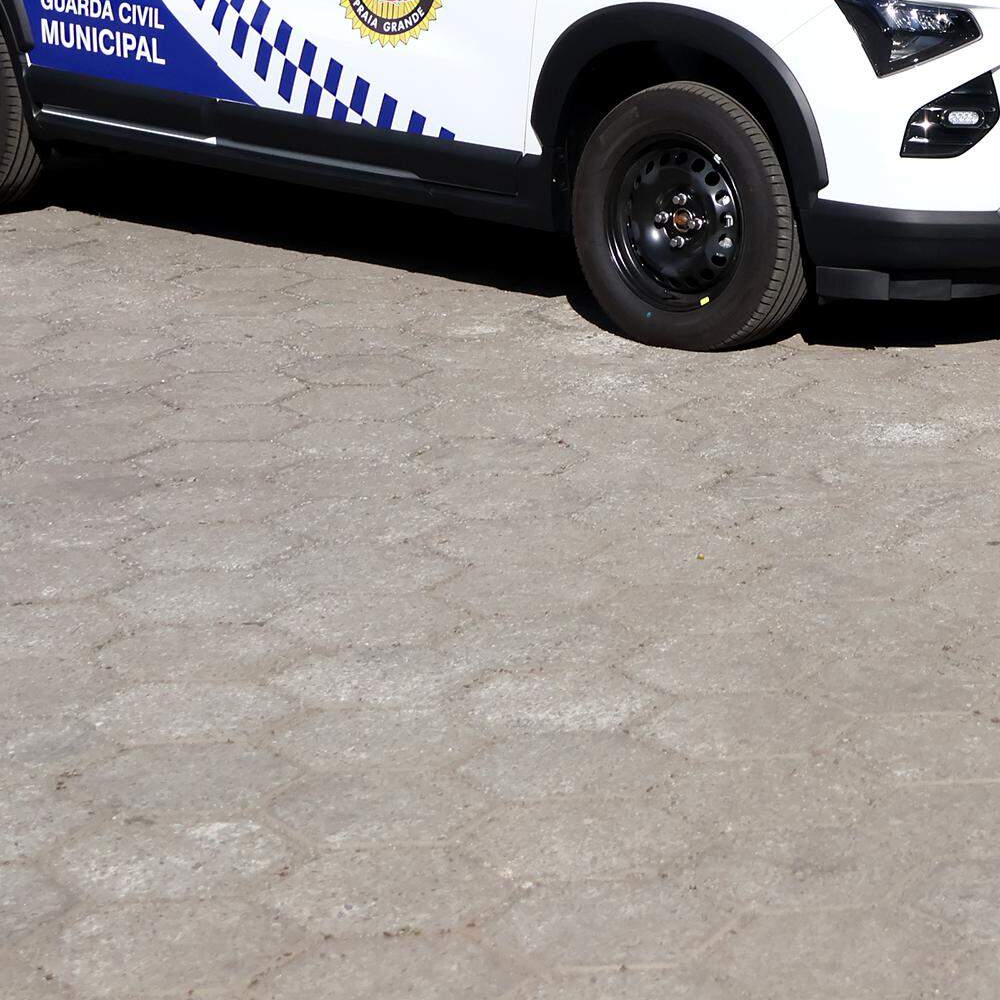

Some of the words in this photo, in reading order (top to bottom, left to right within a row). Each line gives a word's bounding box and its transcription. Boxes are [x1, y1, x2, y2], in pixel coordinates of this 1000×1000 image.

[118, 2, 165, 30] CIVIL
[383, 6, 425, 32] GRANDE
[40, 18, 166, 65] MUNICIPAL
